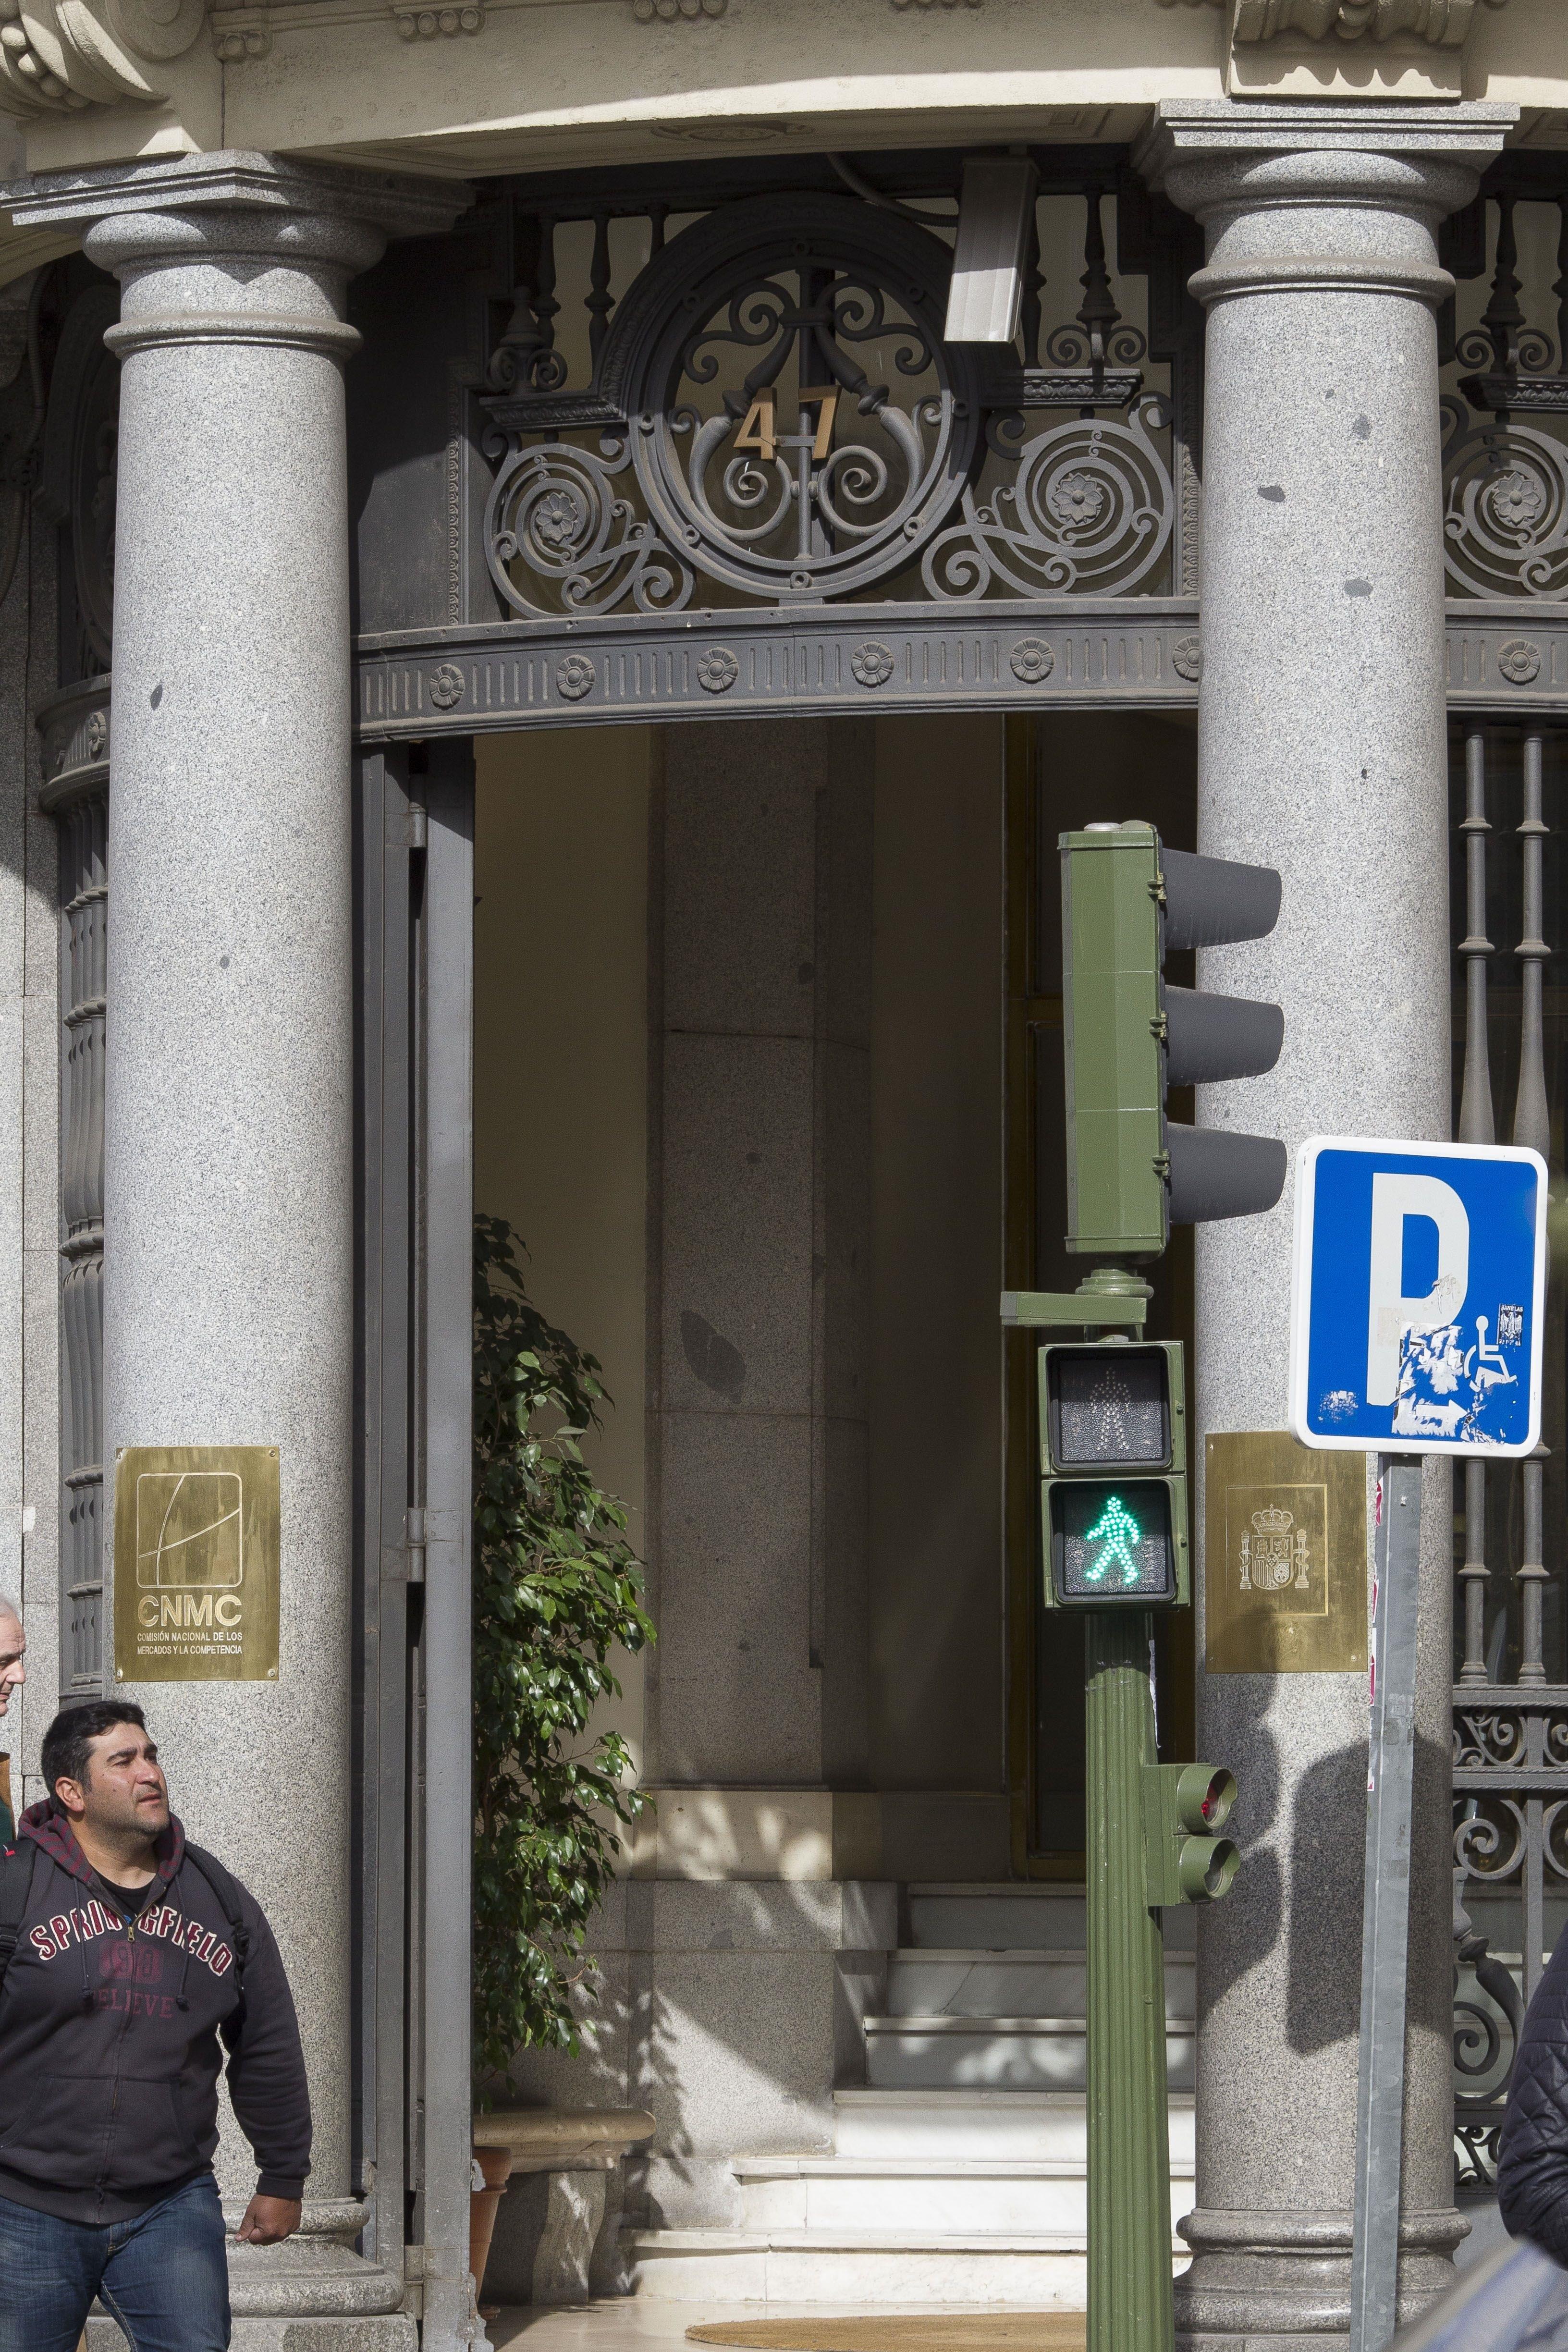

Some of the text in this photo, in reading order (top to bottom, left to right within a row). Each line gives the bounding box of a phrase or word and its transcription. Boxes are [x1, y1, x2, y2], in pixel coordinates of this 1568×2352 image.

[734, 386, 841, 460] 47
[1367, 1172, 1469, 1407] P
[138, 1594, 242, 1627] CNMC
[137, 1630, 242, 1642] COMISIÓN NACIONAL DE LOS
[137, 1645, 242, 1654] MERCADOS Y LA COMPETENCIA
[93, 1988, 174, 2018] ELIEVE
